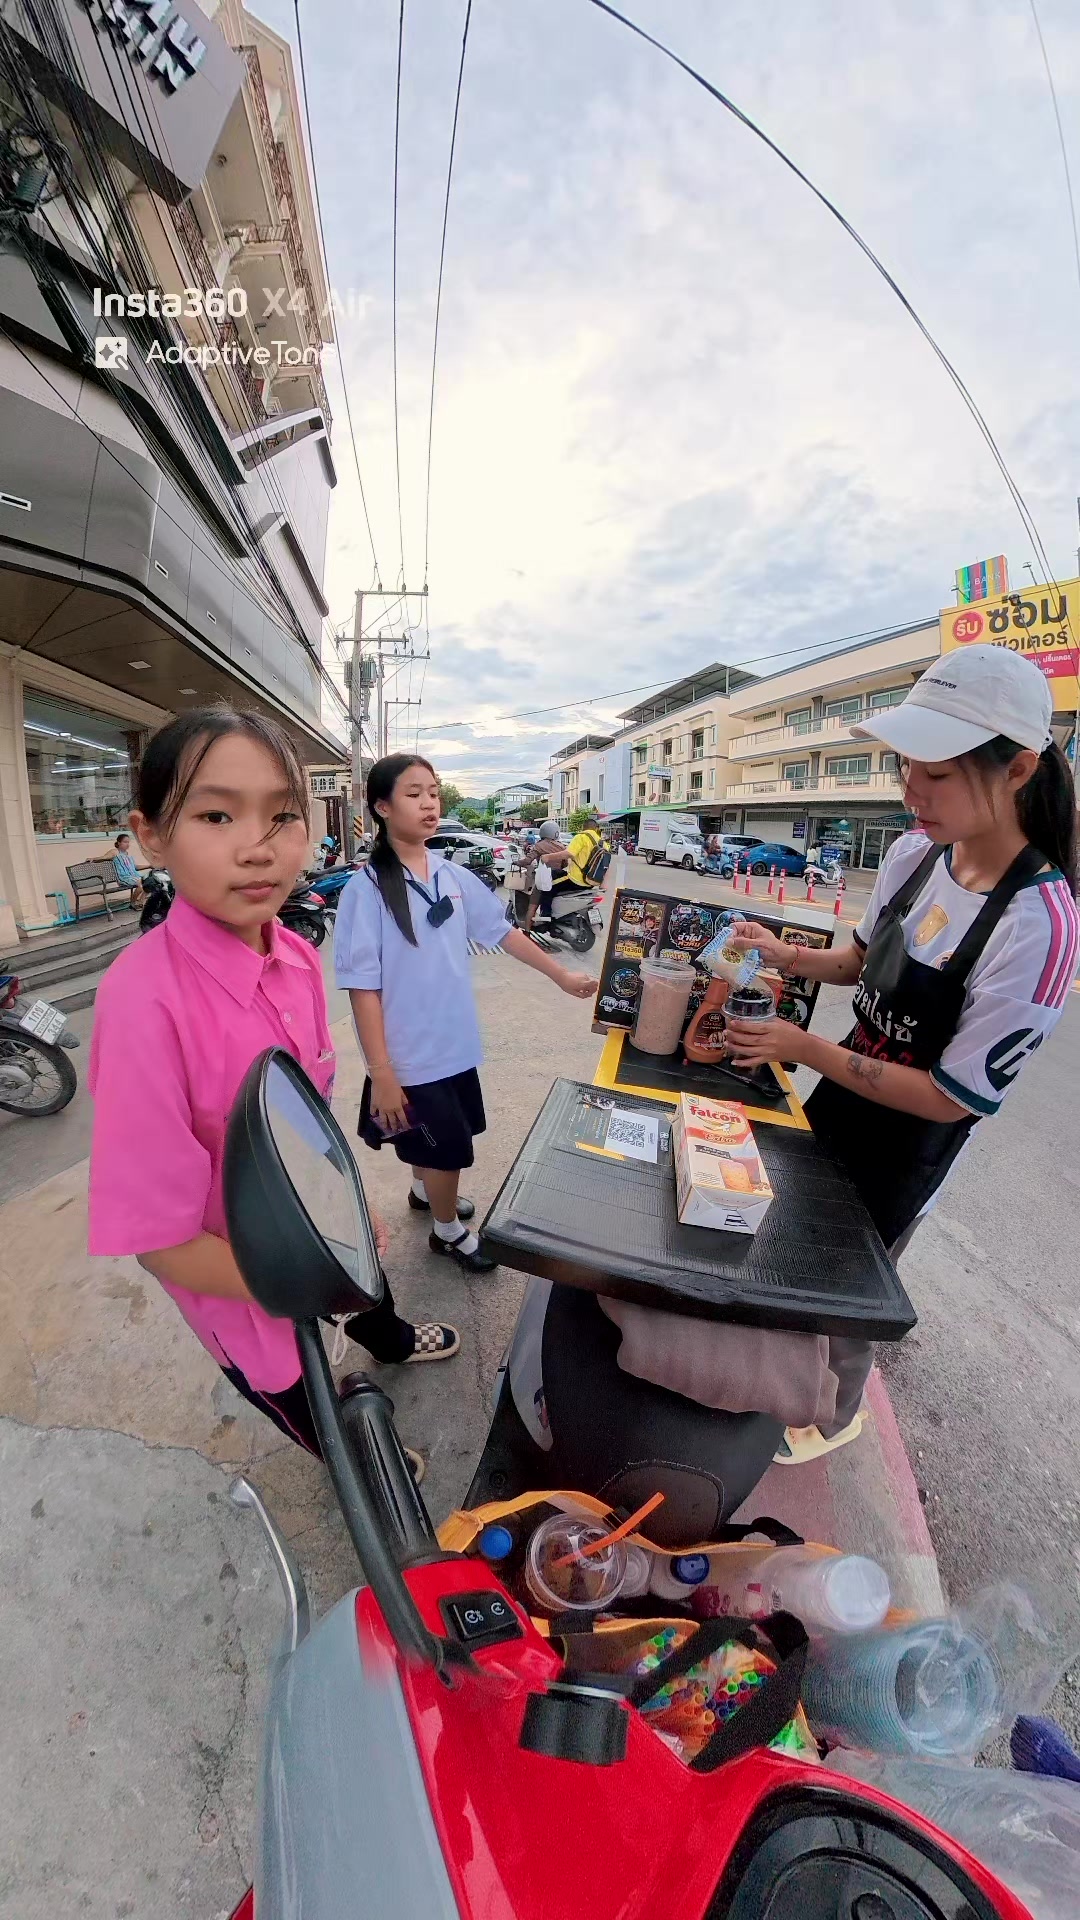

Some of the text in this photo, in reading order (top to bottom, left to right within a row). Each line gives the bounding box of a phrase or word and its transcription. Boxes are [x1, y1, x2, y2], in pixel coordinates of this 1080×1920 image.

[956, 595, 1067, 637] รับ ซ่อม
[615, 944, 643, 955] Insta360
